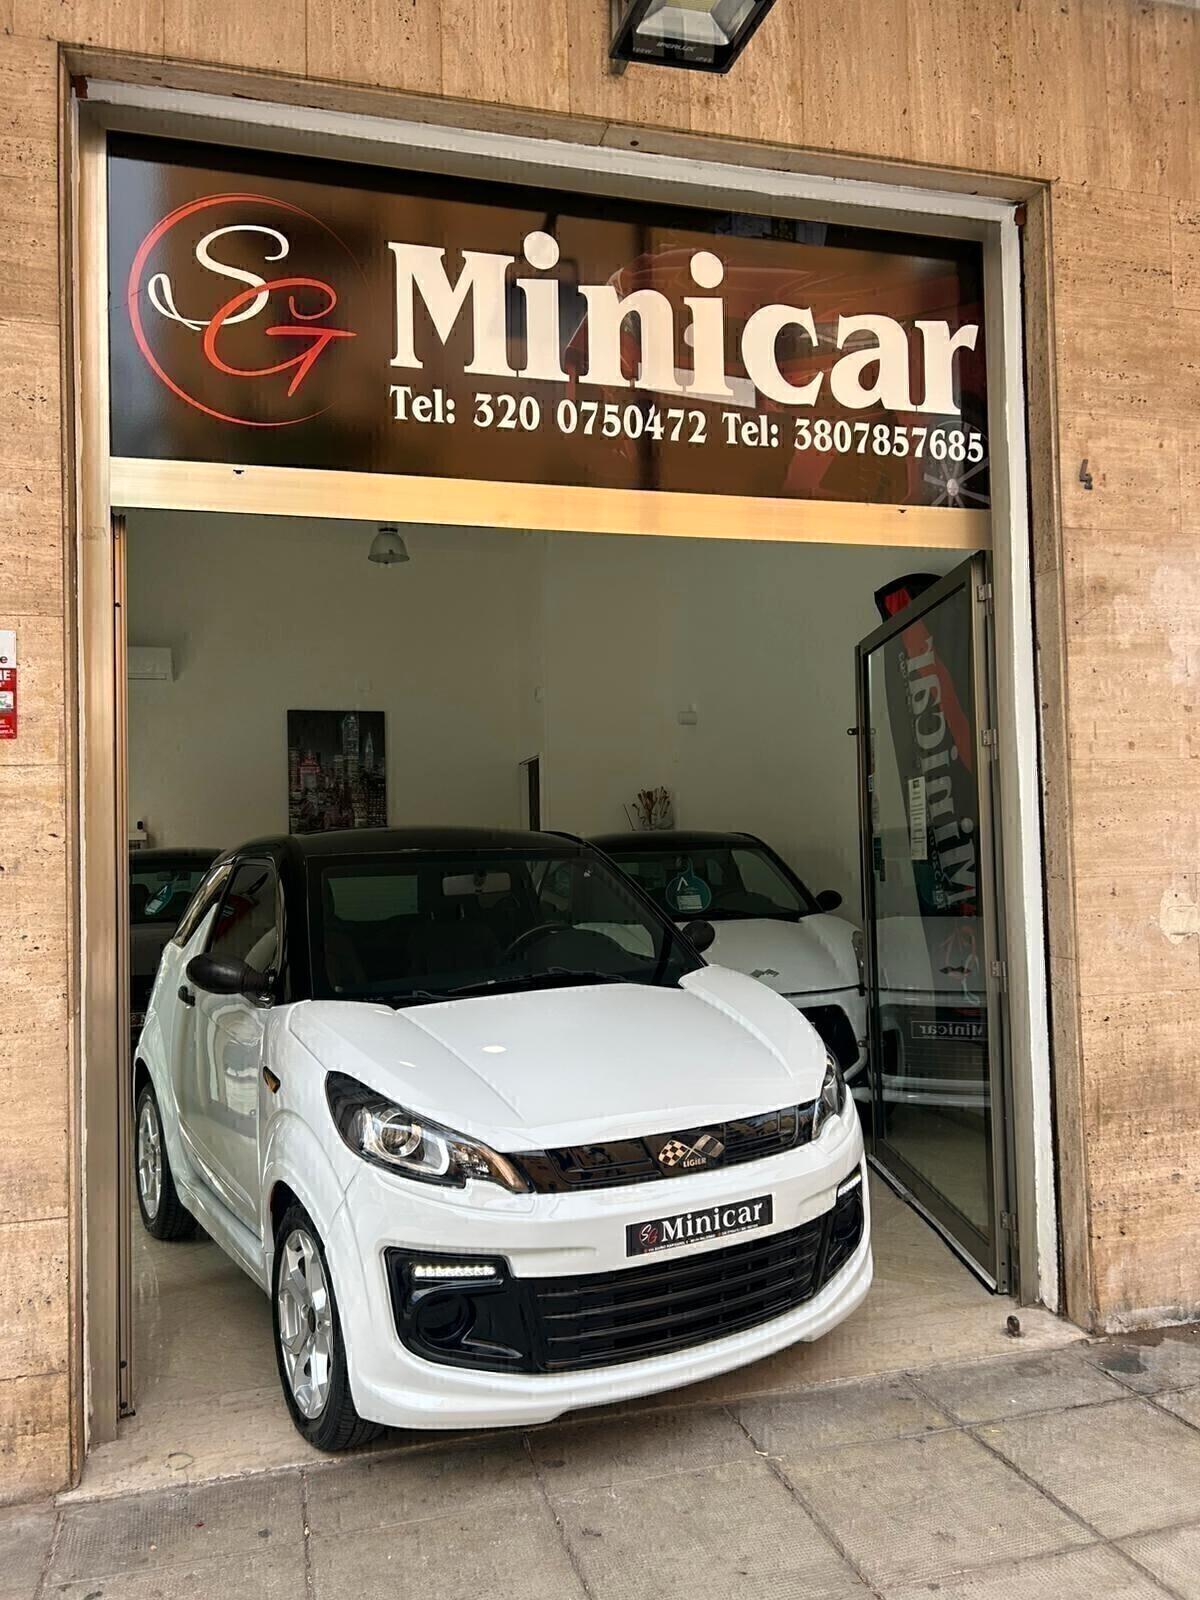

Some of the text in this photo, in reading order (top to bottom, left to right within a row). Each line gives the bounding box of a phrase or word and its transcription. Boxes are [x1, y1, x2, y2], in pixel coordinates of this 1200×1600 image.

[388, 231, 979, 415] Minicar
[389, 384, 984, 462] Tel: 320 0750472 Tel: 3807857685
[661, 1202, 763, 1243] Minicar
